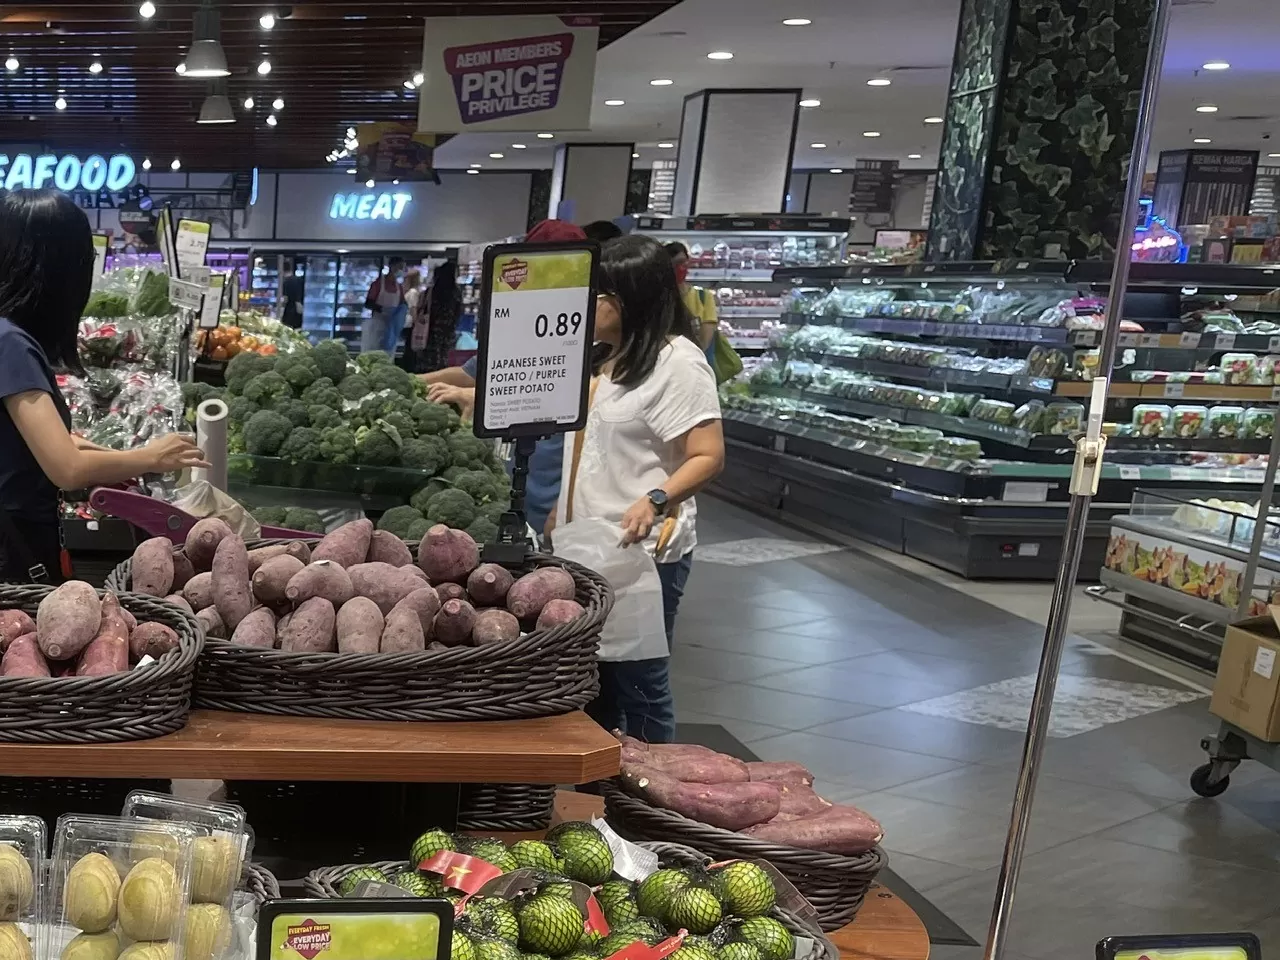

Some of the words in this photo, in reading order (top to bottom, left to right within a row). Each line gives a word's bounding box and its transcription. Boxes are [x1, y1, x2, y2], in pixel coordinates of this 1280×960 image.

[456, 51, 491, 69] AEON
[494, 41, 562, 63] MEMBERS
[461, 62, 558, 102] PRICE
[468, 92, 550, 116] PRIVILEGE
[330, 193, 412, 220] MEAT
[494, 308, 510, 318] RM
[534, 312, 582, 338] 0.89
[491, 357, 537, 370] JAPANESE
[539, 355, 566, 366] SWEET
[490, 371, 527, 383] POTATO
[536, 369, 566, 379] PURPLE
[490, 386, 517, 396] SWEET
[520, 382, 555, 394] POTATO
[293, 932, 330, 944] EVERYDAY
